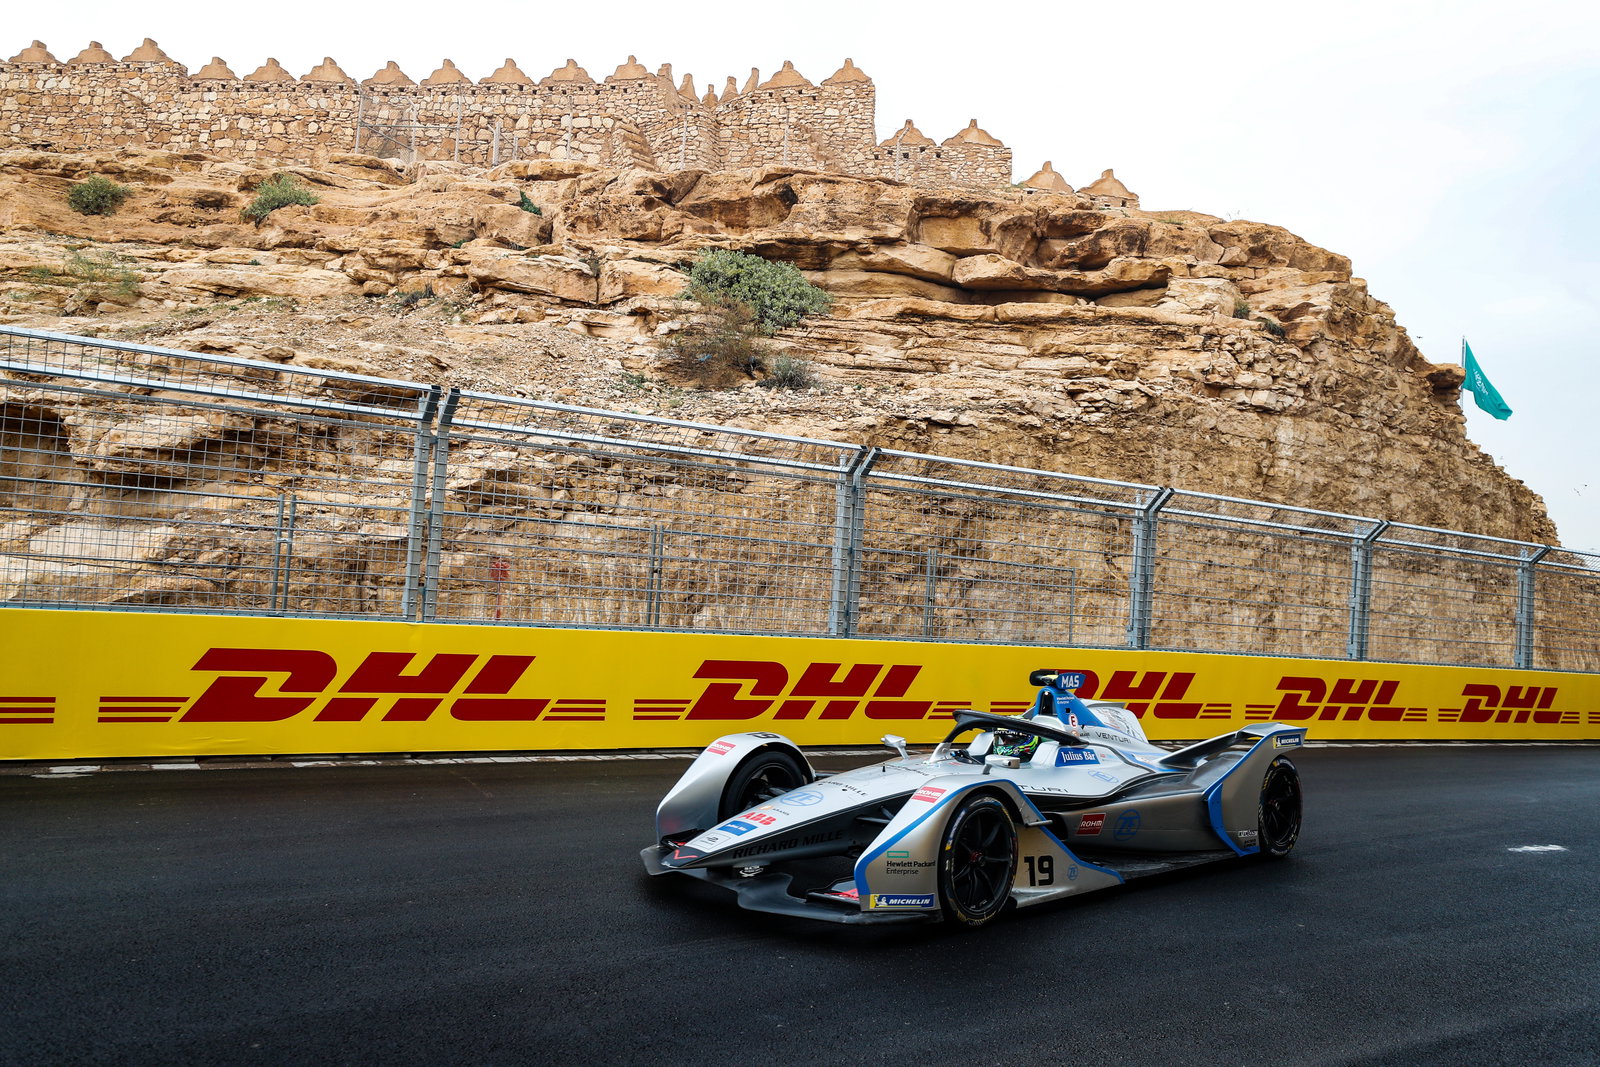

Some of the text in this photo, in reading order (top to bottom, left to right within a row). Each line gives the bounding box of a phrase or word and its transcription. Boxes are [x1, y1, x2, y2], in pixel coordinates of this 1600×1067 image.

[178, 648, 536, 722] DHL
[685, 660, 933, 721] DHL
[1061, 674, 1080, 688] MAS
[1272, 676, 1406, 722] DHL
[1459, 683, 1563, 724] DHL
[1095, 731, 1132, 744] VENTURI
[1061, 751, 1083, 763] Julius
[1083, 751, 1096, 761] Bär
[782, 790, 824, 806] ZF
[917, 789, 942, 799] ROHM
[1018, 784, 1069, 793] TURI
[738, 812, 777, 825] ABB
[1115, 811, 1141, 838] ZF
[732, 837, 798, 859] RICHARD
[802, 829, 843, 846] MILLE
[1024, 855, 1054, 887] 19
